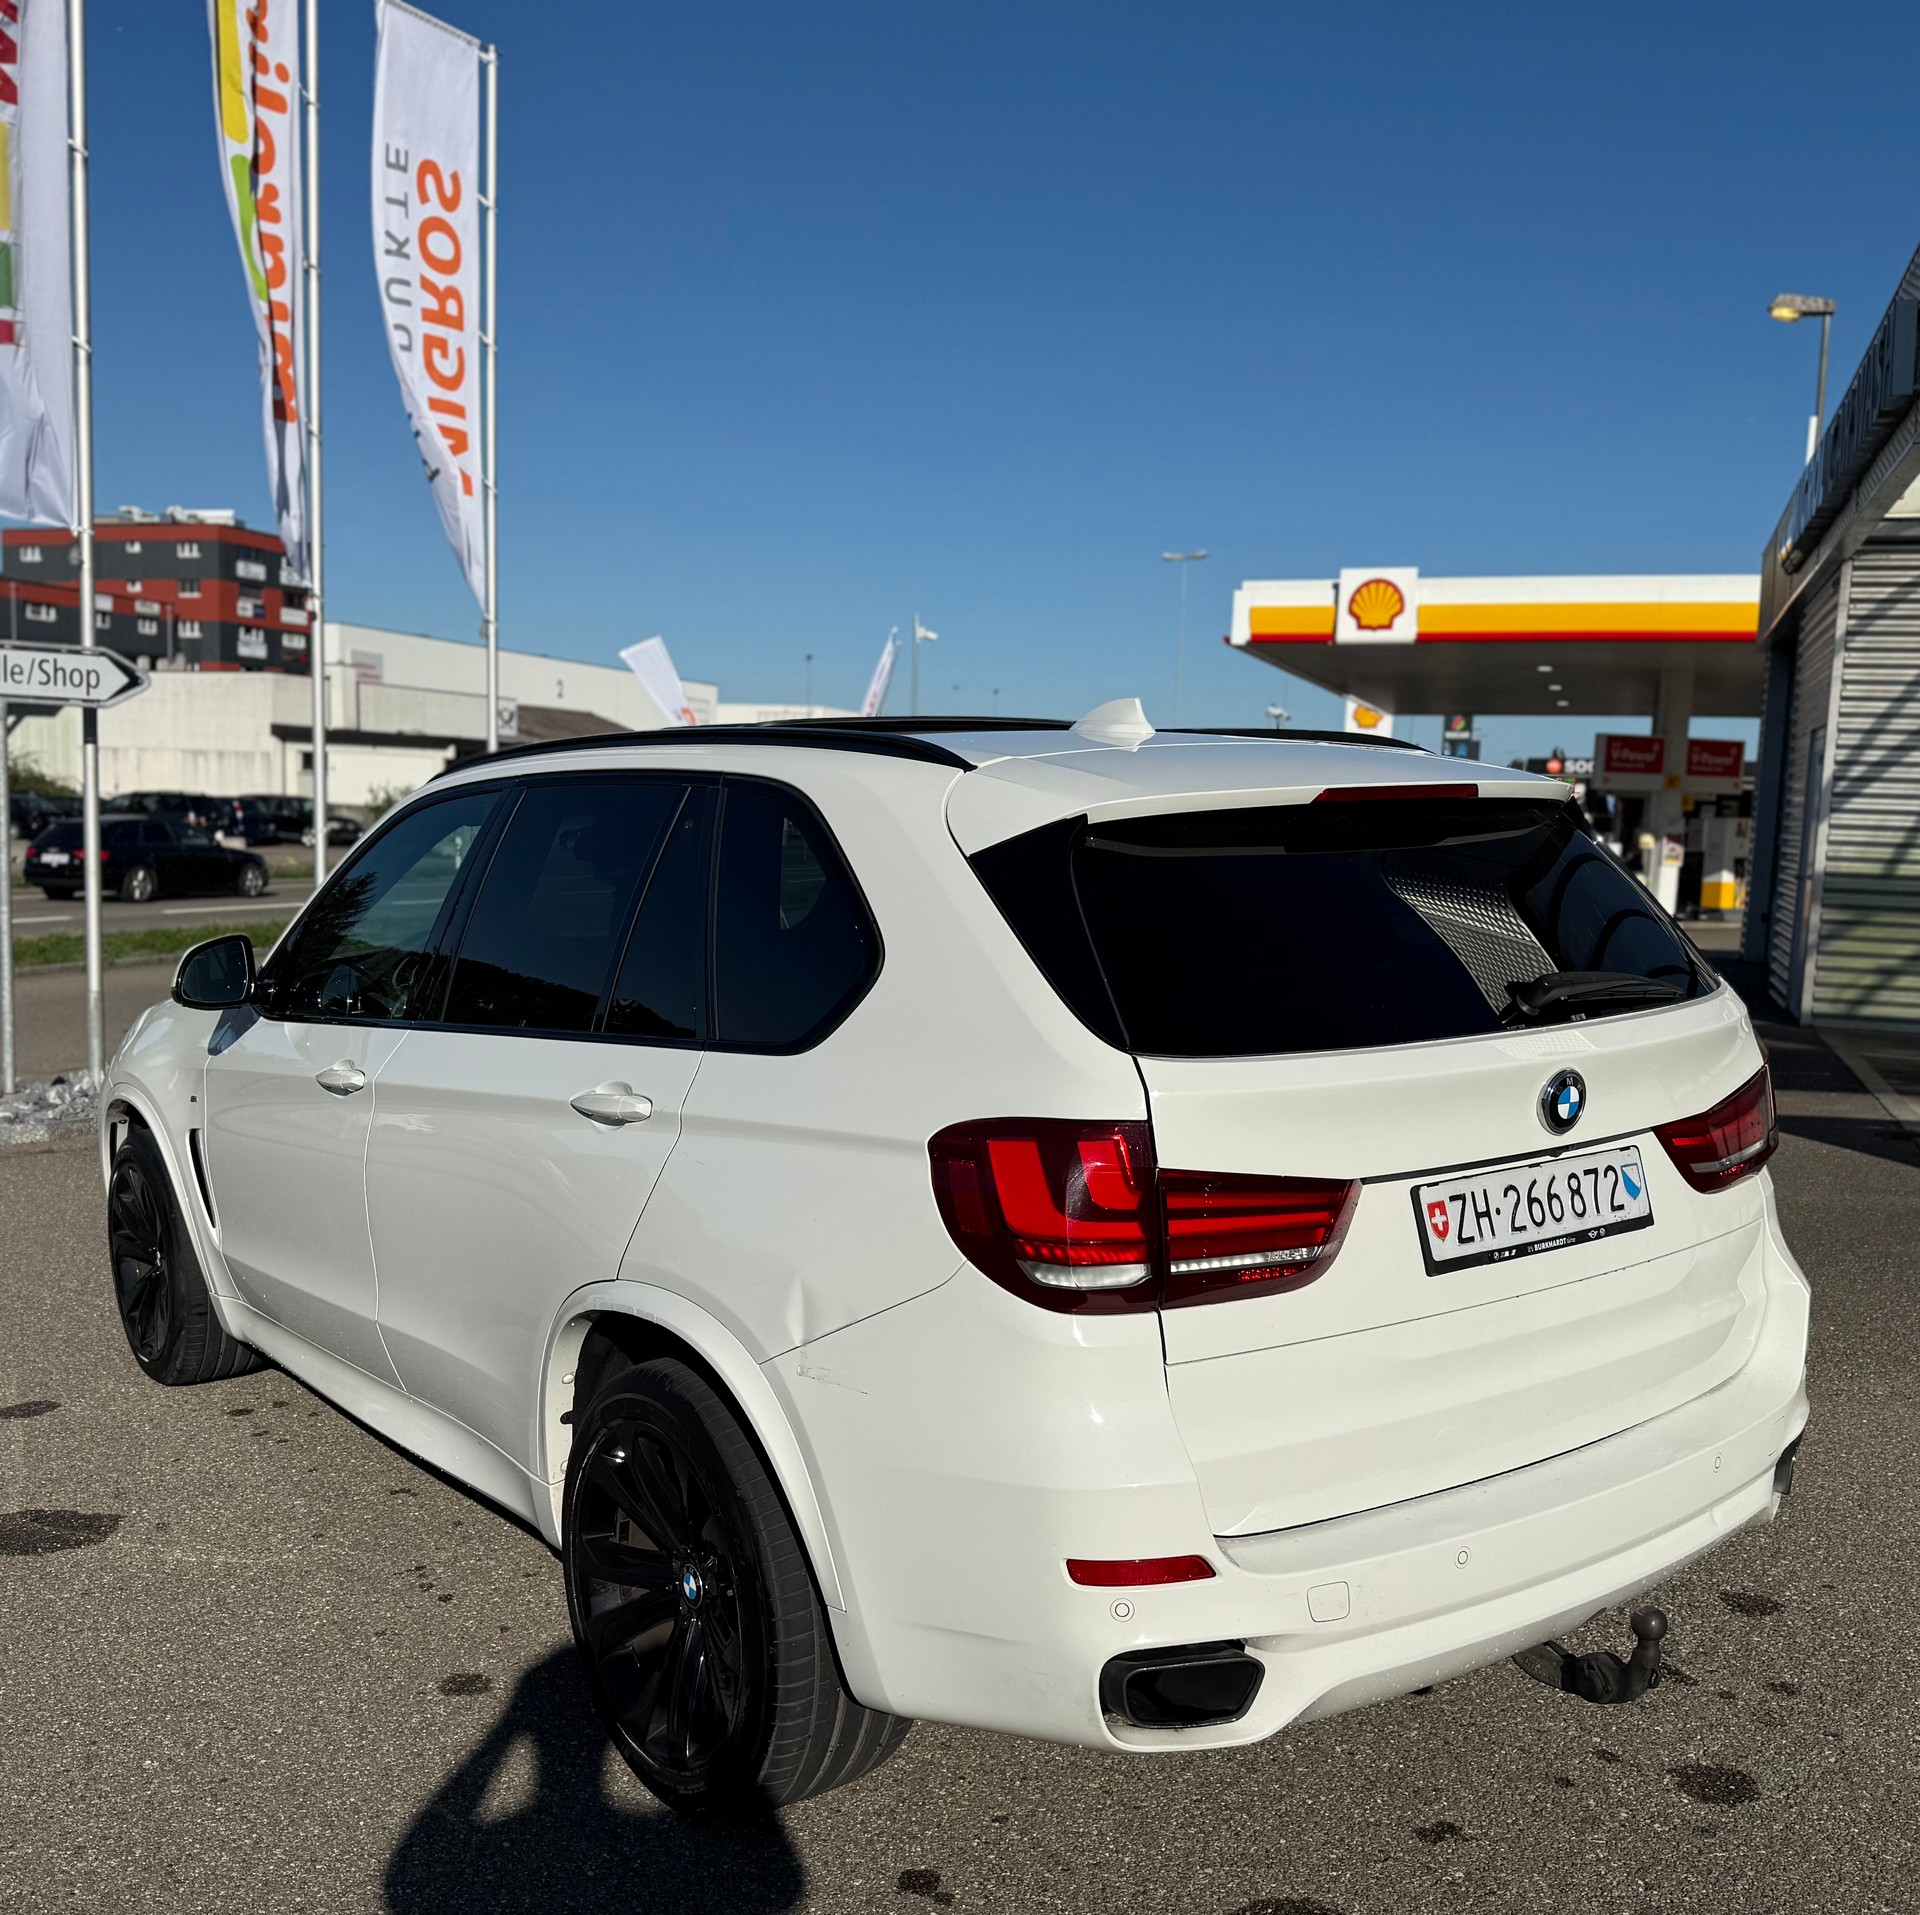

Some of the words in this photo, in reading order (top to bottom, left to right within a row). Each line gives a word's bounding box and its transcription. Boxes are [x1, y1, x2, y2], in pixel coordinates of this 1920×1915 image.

[3, 654, 101, 696] le/Shop
[1554, 1076, 1583, 1096] BMW
[1534, 1237, 1567, 1252] BURKHARDT
